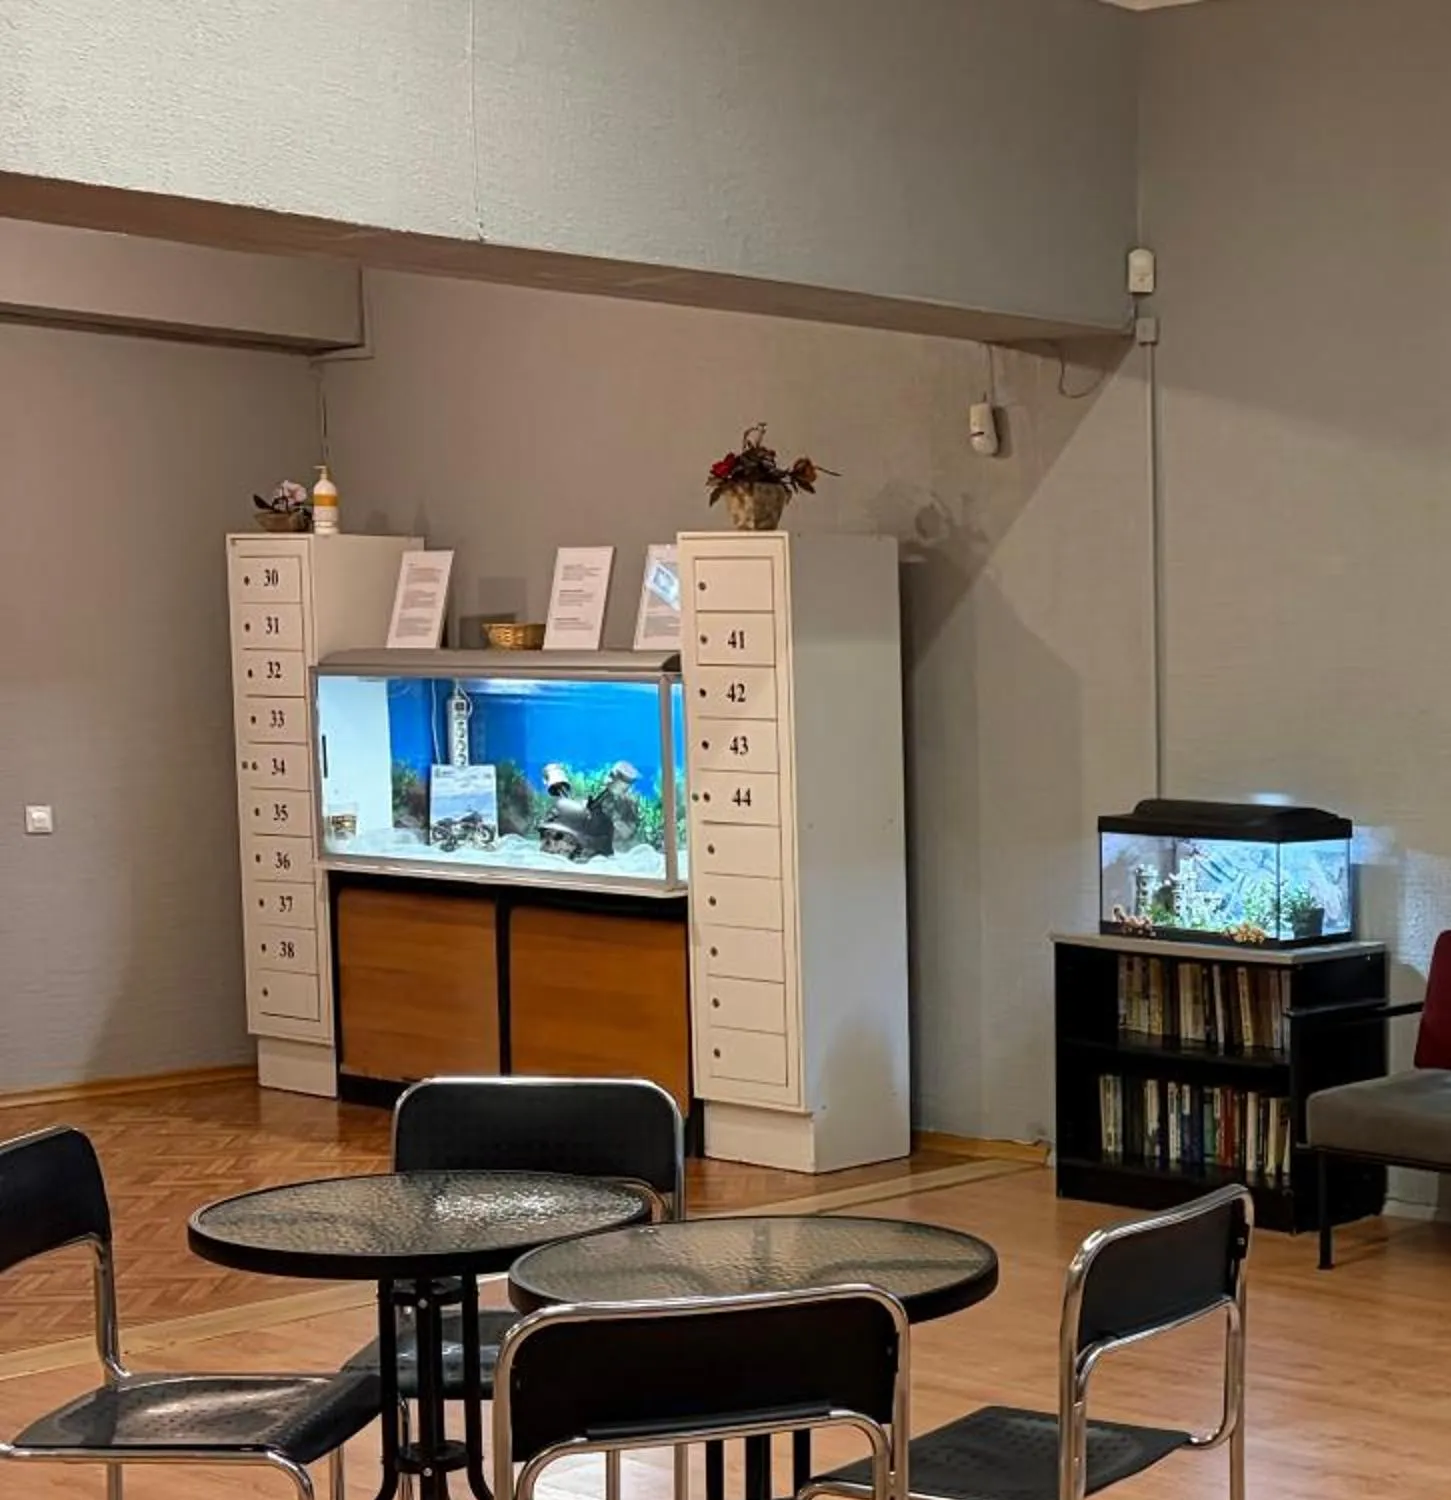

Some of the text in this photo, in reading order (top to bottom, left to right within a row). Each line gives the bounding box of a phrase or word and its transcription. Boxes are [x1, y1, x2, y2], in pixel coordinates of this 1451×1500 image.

[263, 568, 279, 587] 30
[265, 615, 279, 635] 31
[727, 630, 745, 650] 41
[267, 660, 282, 679] 32
[725, 683, 746, 703] 42
[269, 709, 285, 729] 33
[729, 735, 749, 755] 43
[271, 757, 286, 775] 34
[731, 787, 752, 807] 44
[273, 803, 289, 821] 35
[274, 851, 291, 870] 36
[279, 895, 294, 913] 37
[279, 941, 295, 959] 38
